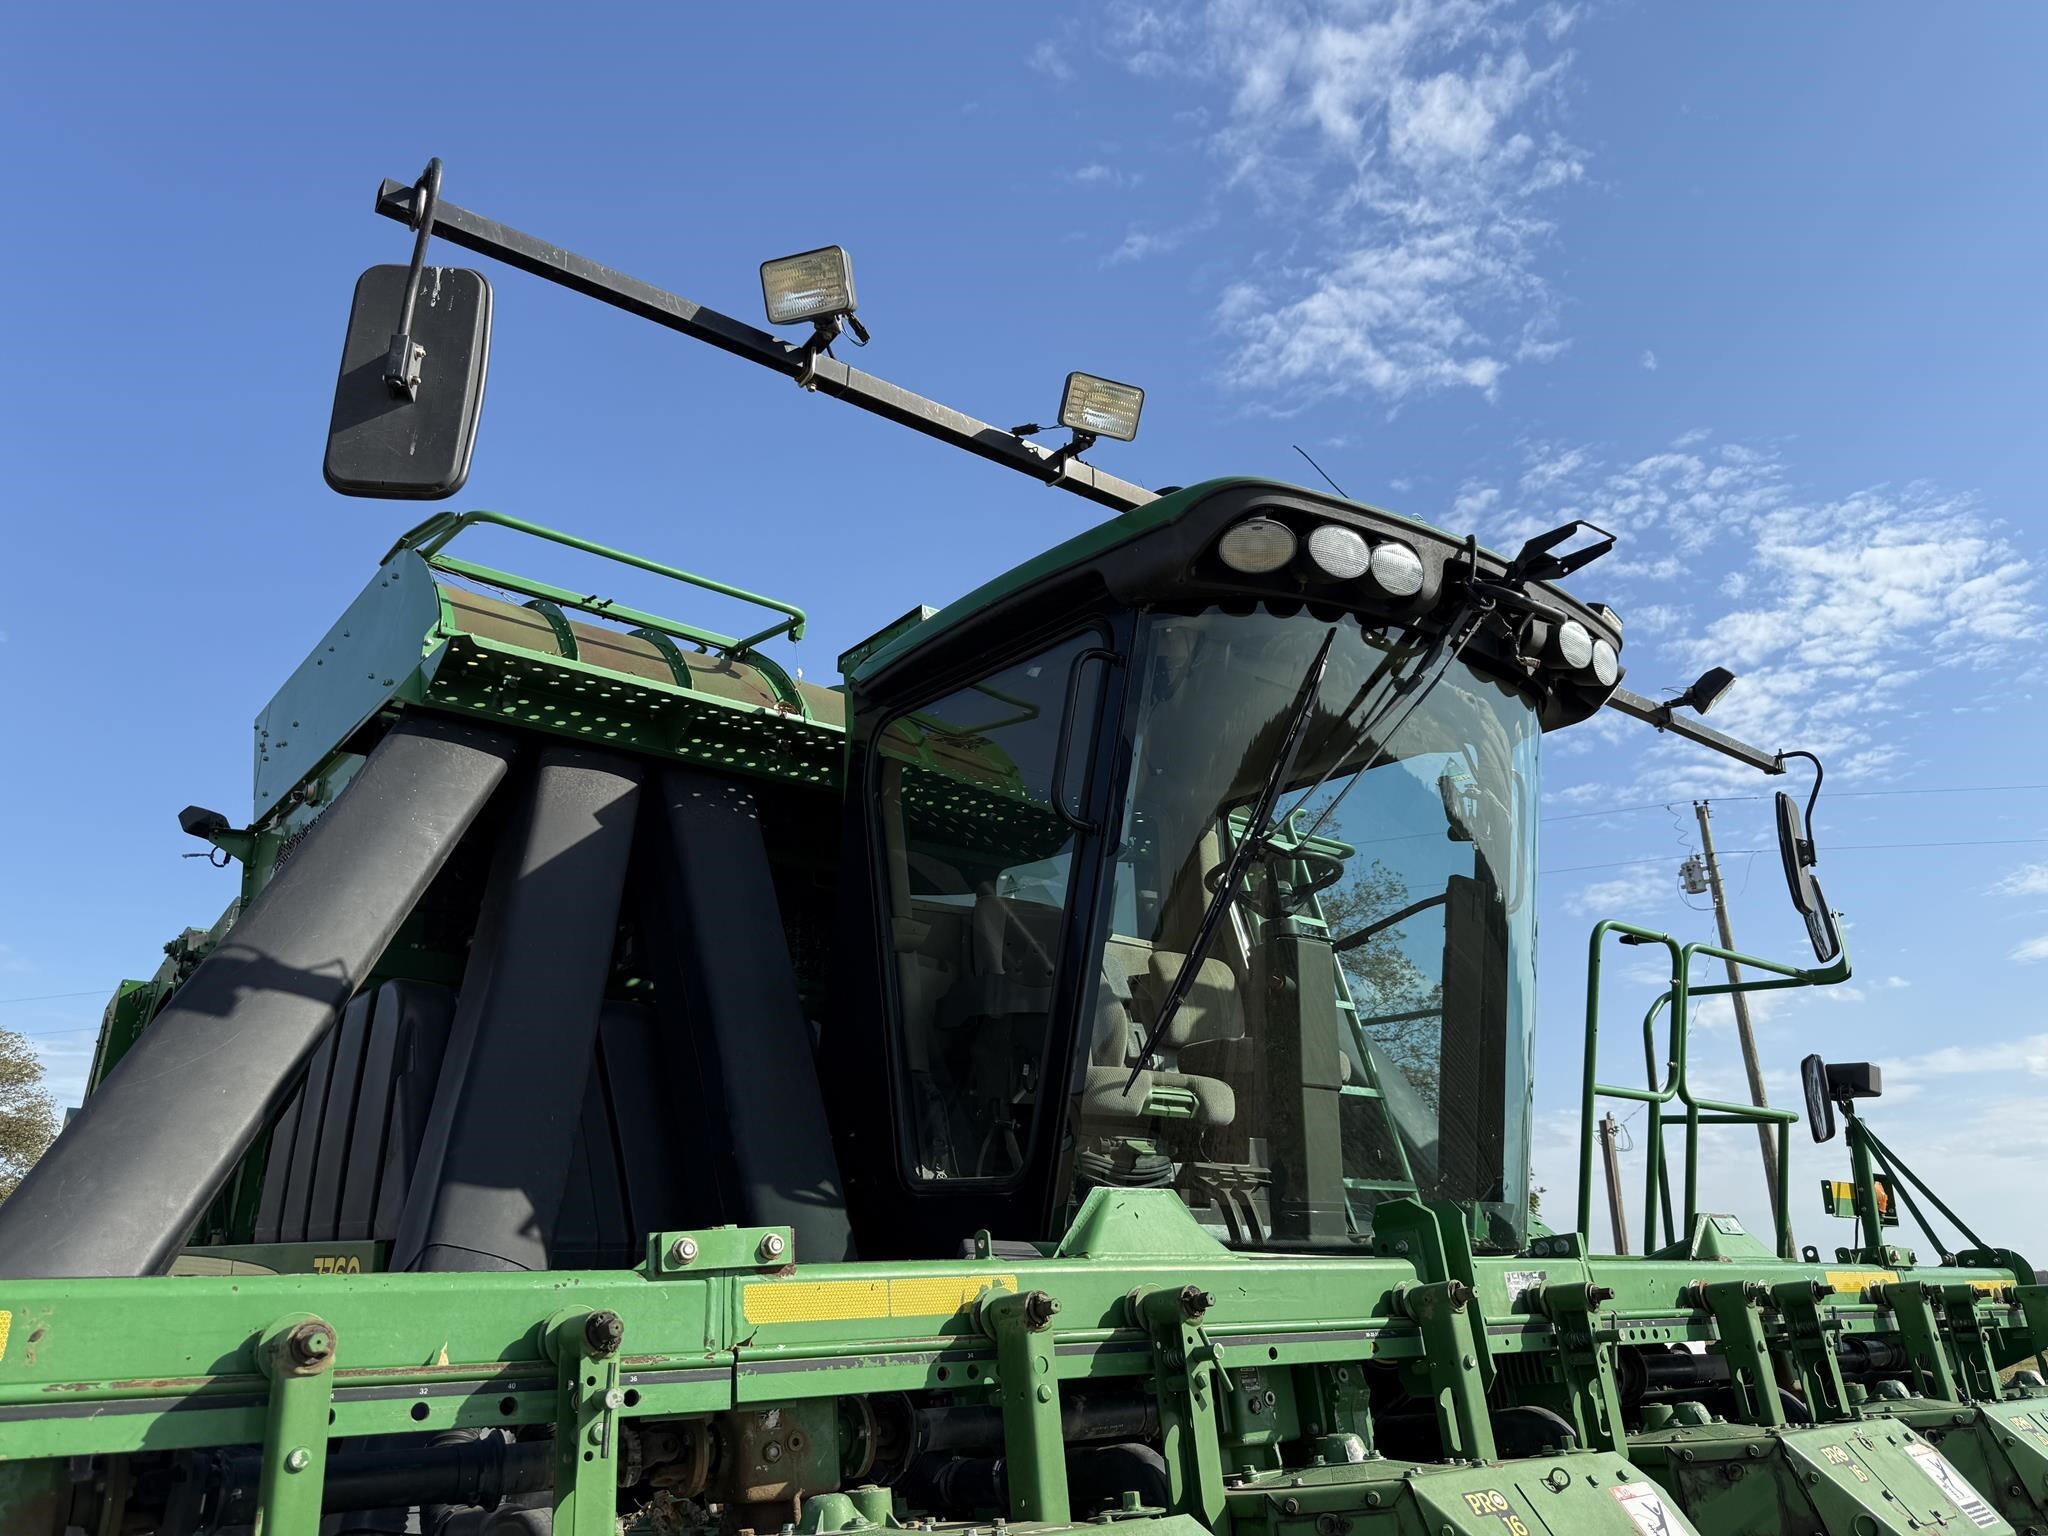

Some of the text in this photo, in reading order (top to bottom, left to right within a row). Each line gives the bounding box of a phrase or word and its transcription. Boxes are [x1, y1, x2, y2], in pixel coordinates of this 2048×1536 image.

[1849, 1465, 1868, 1481] 16
[1464, 1490, 1508, 1515] PRO
[1502, 1515, 1528, 1536] 16
